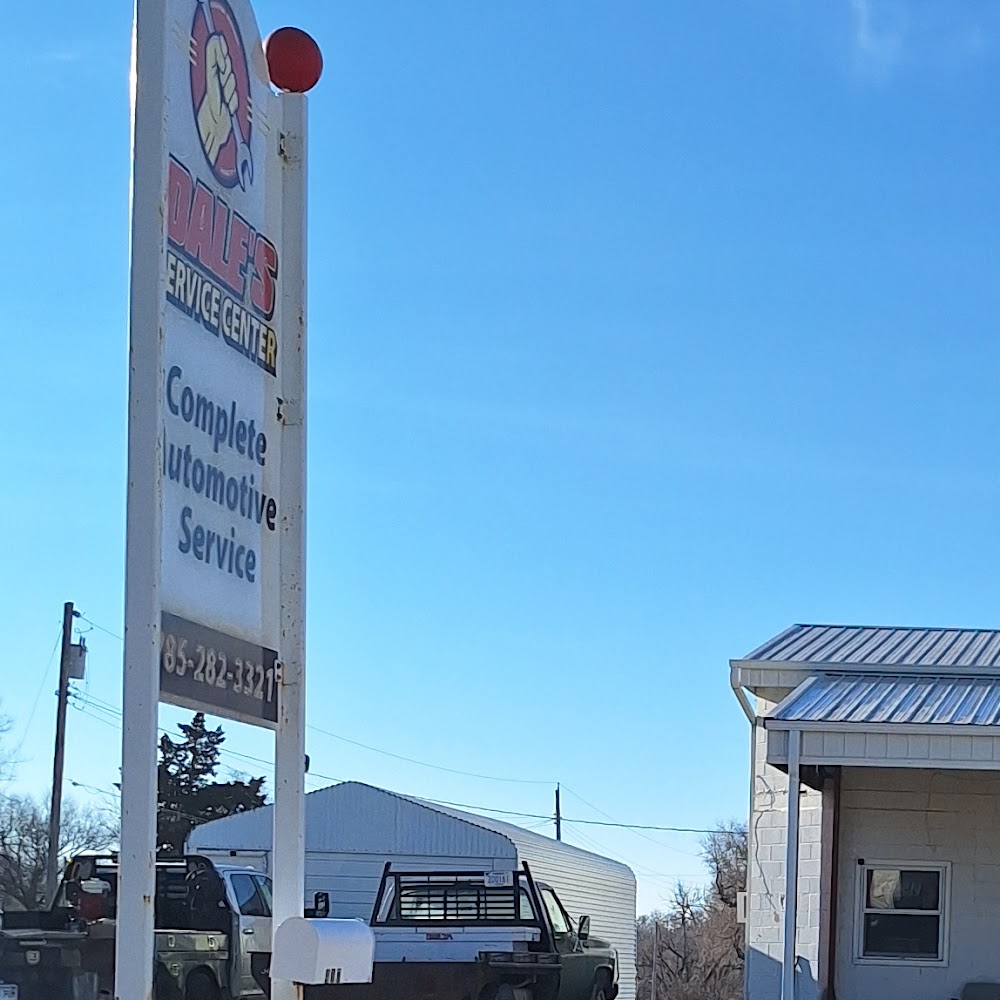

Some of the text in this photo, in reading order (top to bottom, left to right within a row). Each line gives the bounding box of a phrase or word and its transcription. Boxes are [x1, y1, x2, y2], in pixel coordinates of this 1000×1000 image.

[168, 154, 278, 319] DALE'S
[166, 253, 277, 373] ERVICE CENTER
[166, 365, 267, 467] Complete
[163, 426, 277, 531] utomotive
[178, 506, 256, 584] Service
[162, 633, 274, 703] 85-282-3321
